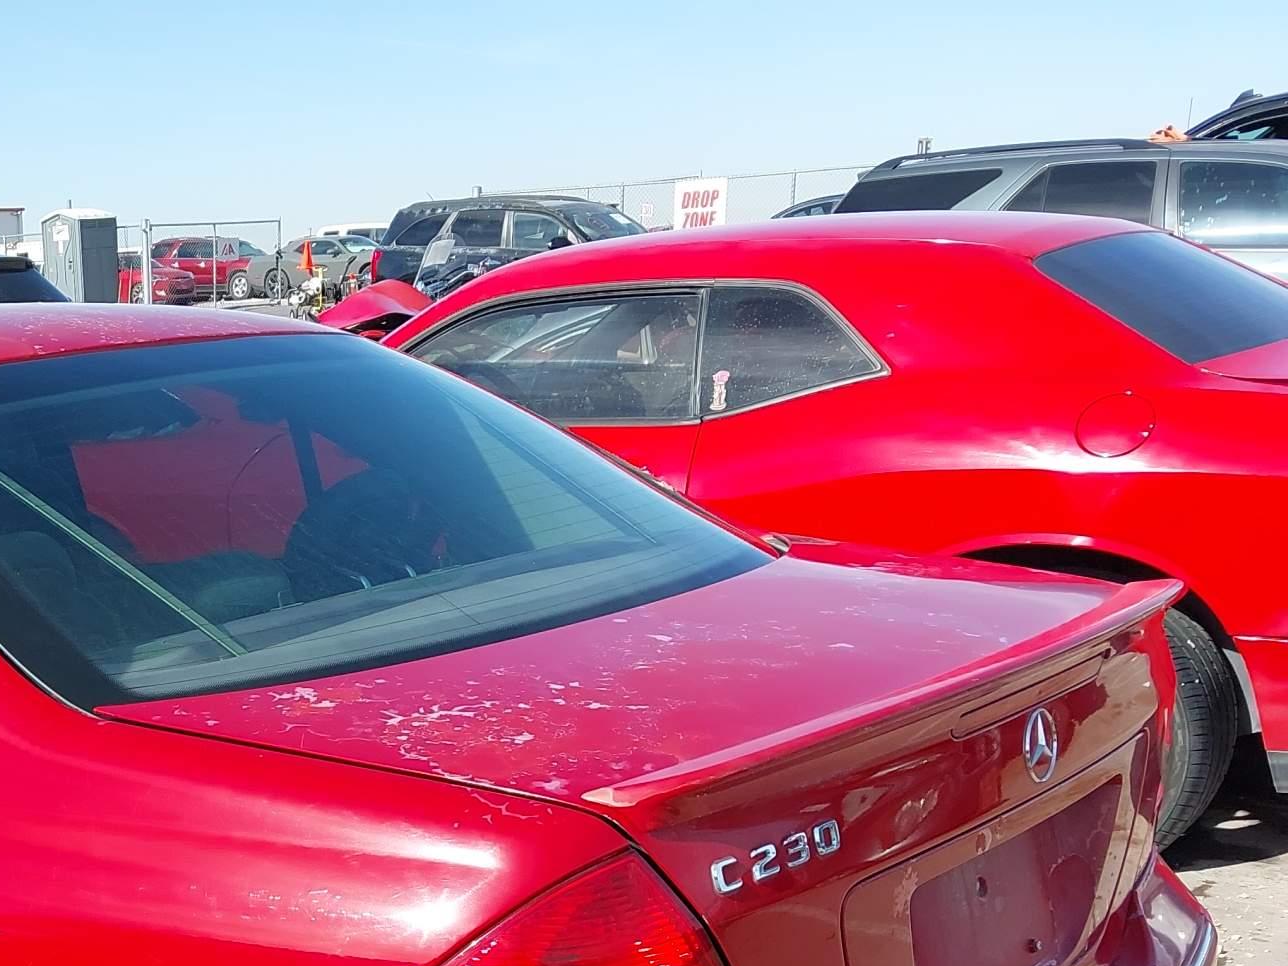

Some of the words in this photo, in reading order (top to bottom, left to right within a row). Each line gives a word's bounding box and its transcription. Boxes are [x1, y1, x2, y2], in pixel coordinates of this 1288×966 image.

[681, 190, 720, 209] DROP
[681, 211, 718, 229] ZONE
[710, 856, 744, 894] C
[749, 819, 841, 881] 230
